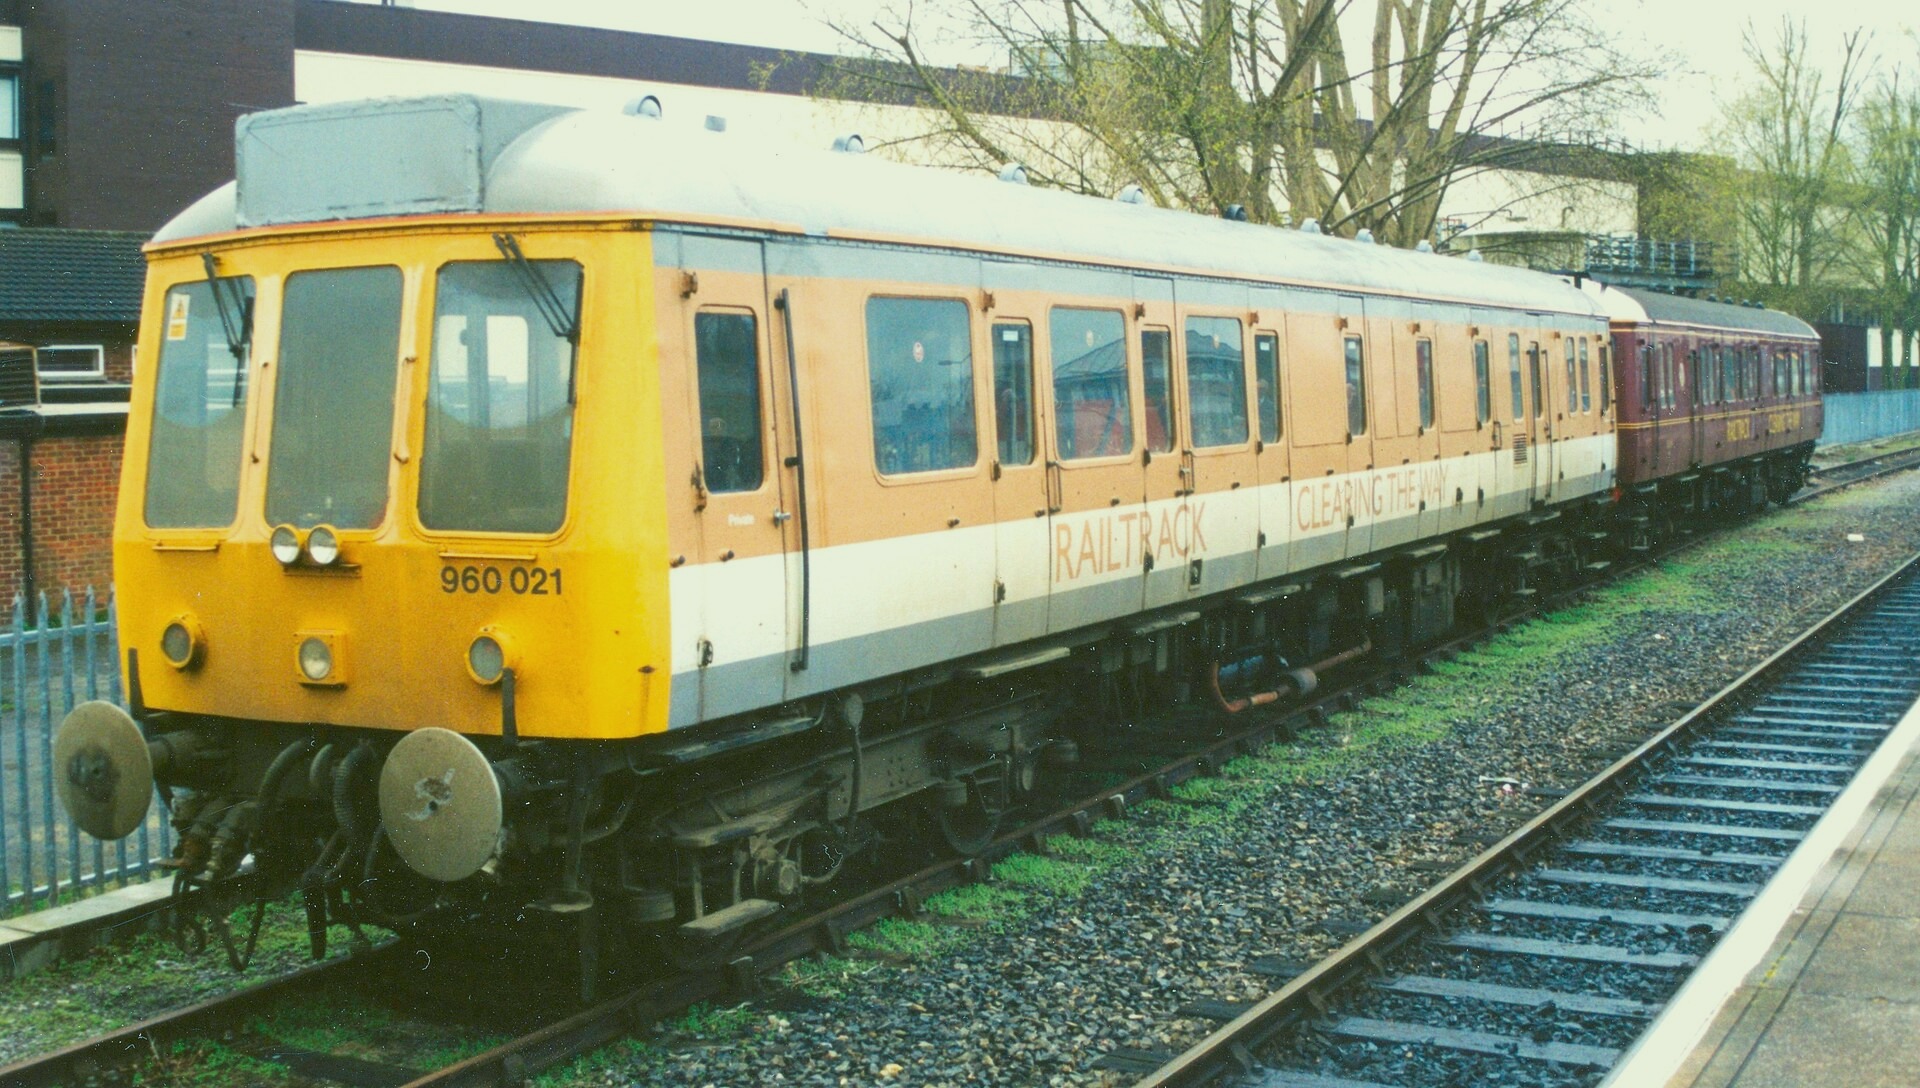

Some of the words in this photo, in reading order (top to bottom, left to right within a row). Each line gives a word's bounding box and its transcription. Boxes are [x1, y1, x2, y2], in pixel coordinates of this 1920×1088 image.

[1296, 474, 1384, 532] CLEARING
[1387, 469, 1416, 514] THE
[1421, 463, 1449, 503] WAY
[1055, 501, 1207, 583] RAILTRACK
[440, 565, 502, 595] 960
[509, 566, 562, 595] 021
